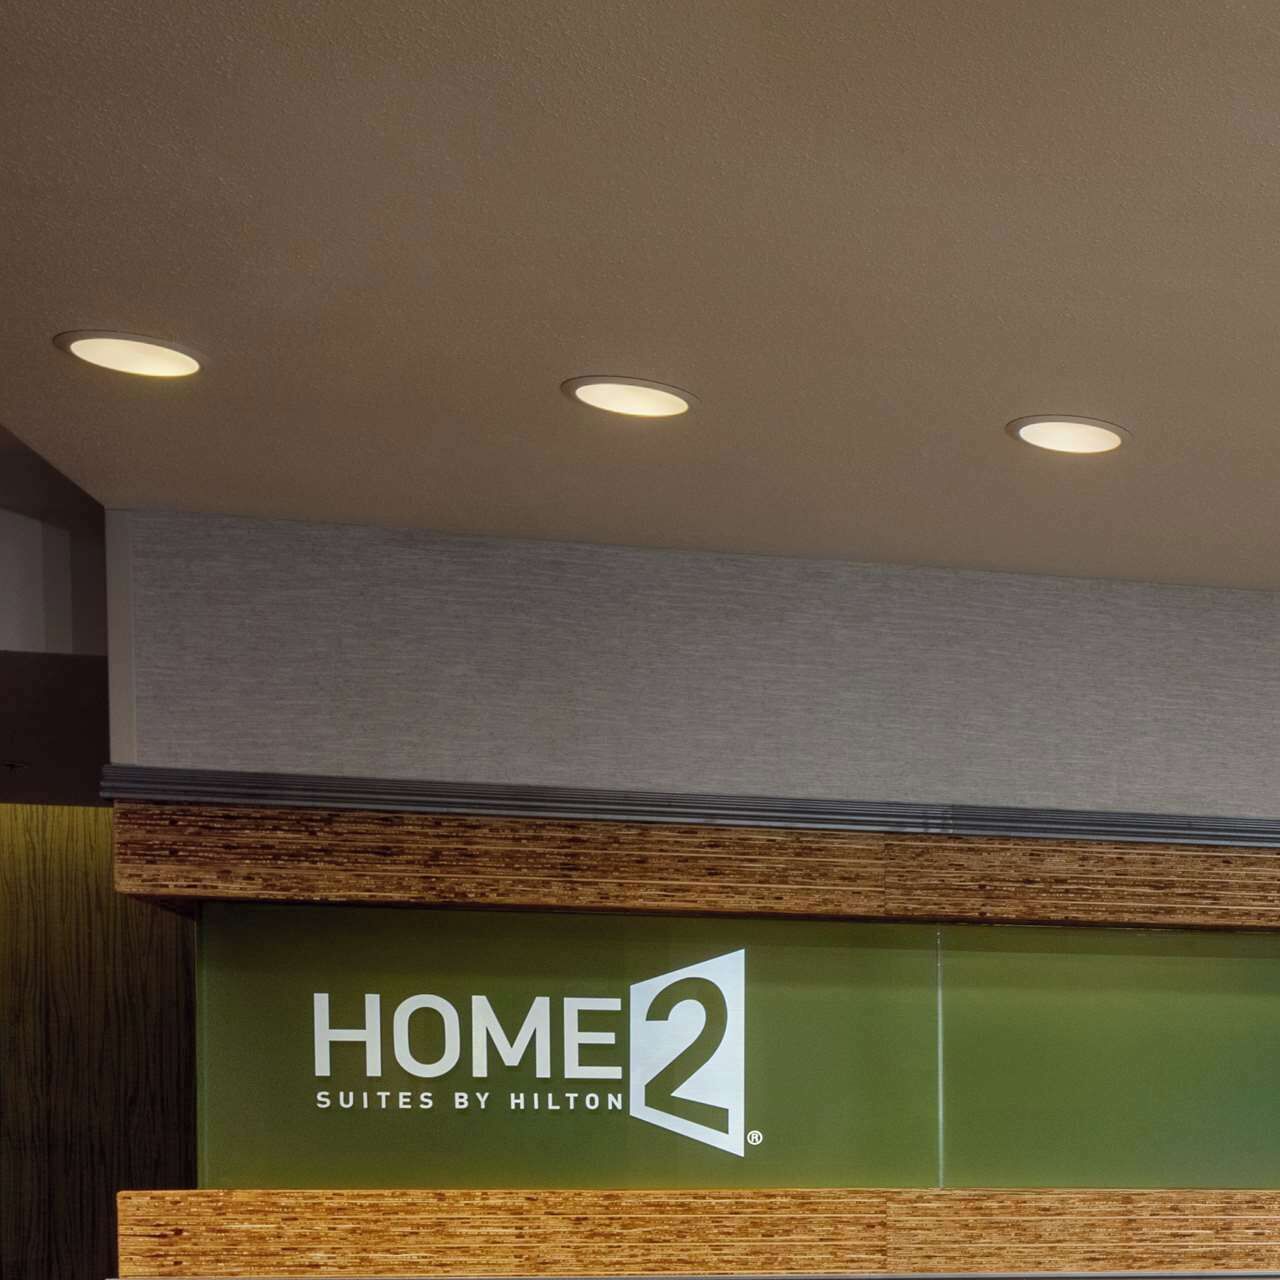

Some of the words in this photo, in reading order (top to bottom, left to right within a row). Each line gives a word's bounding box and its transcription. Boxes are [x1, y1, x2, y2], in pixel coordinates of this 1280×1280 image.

[315, 1091, 434, 1109] SUITES
[454, 1092, 489, 1110] BY
[510, 1093, 623, 1111] HILTON
